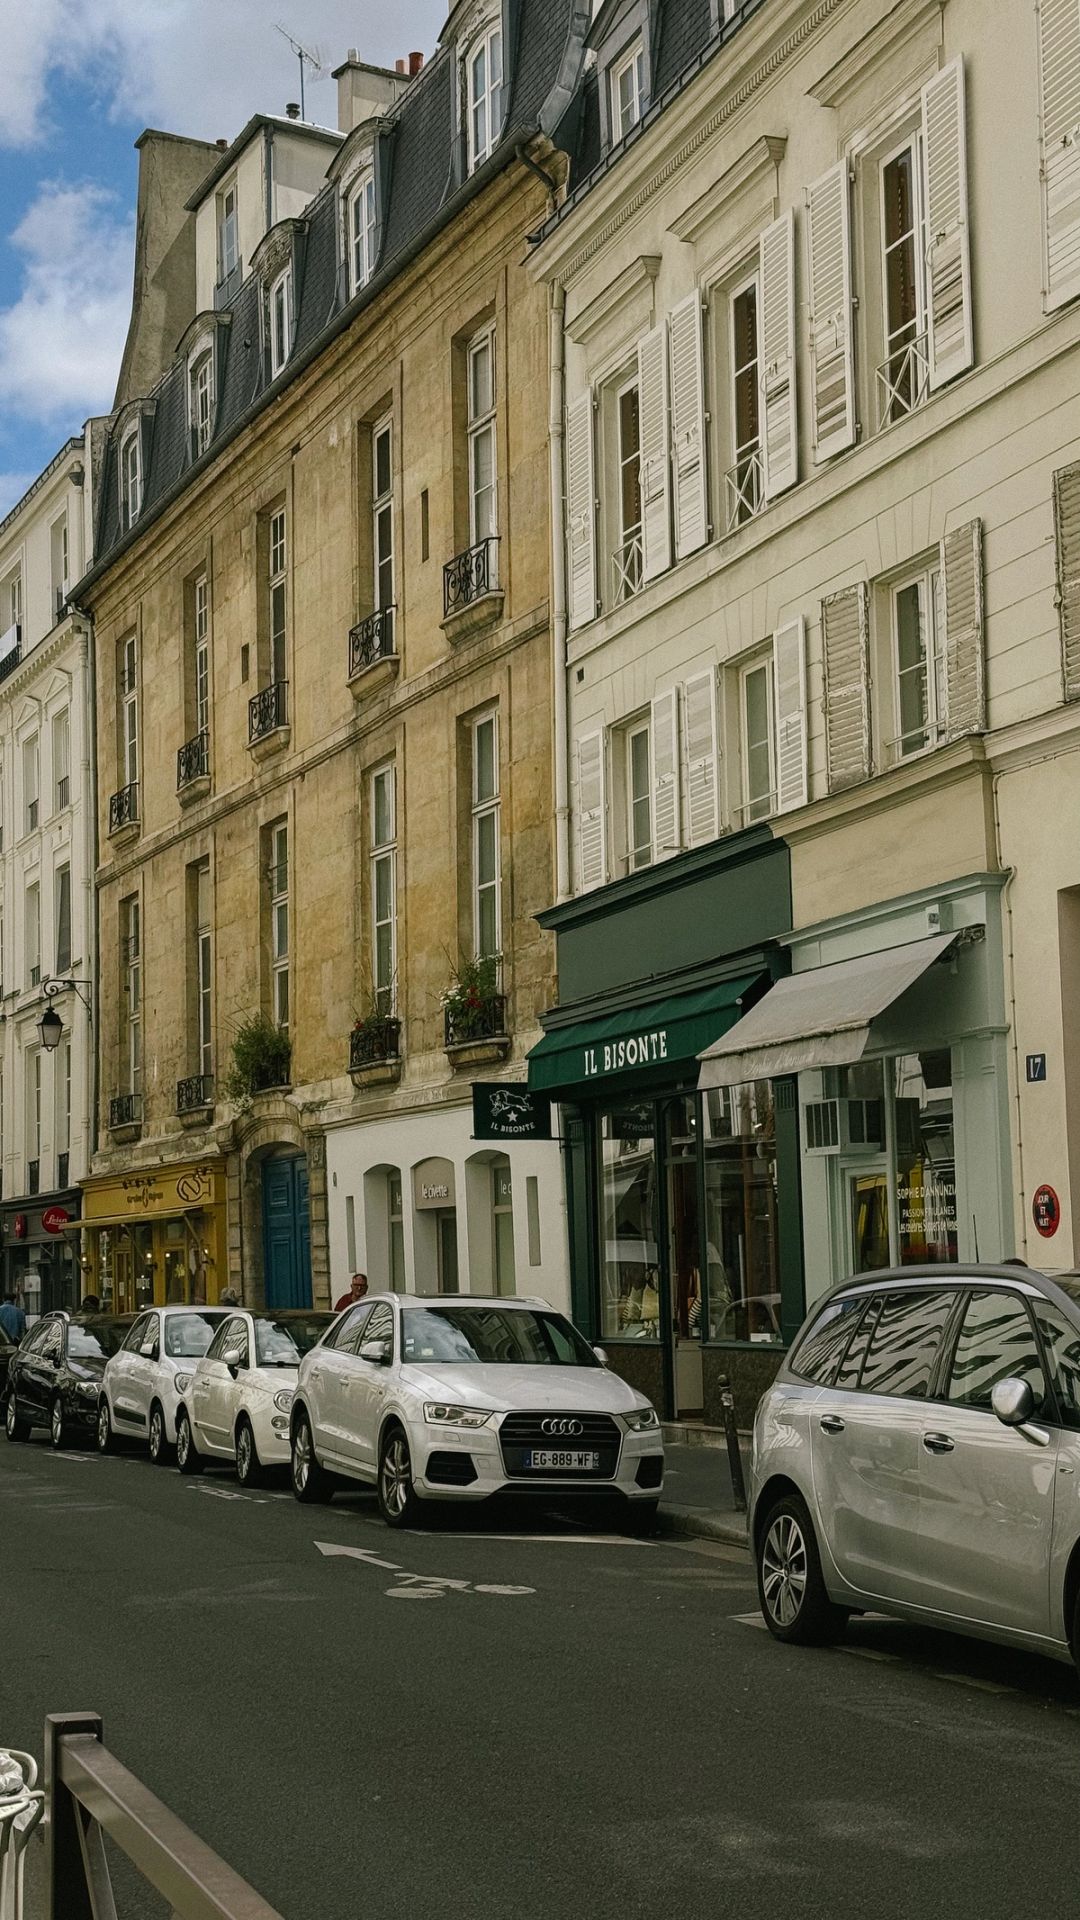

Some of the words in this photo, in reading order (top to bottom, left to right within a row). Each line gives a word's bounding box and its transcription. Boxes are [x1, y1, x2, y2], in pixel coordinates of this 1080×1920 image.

[584, 1049, 598, 1076] IL
[604, 1030, 667, 1071] BISONTE
[1030, 1057, 1041, 1078] 17
[490, 1121, 499, 1131] IL
[500, 1121, 536, 1133] BISONTE
[897, 1186, 920, 1200] SOPHIE
[1040, 1206, 1046, 1215] ET
[532, 1452, 591, 1467] EG-889-WF
